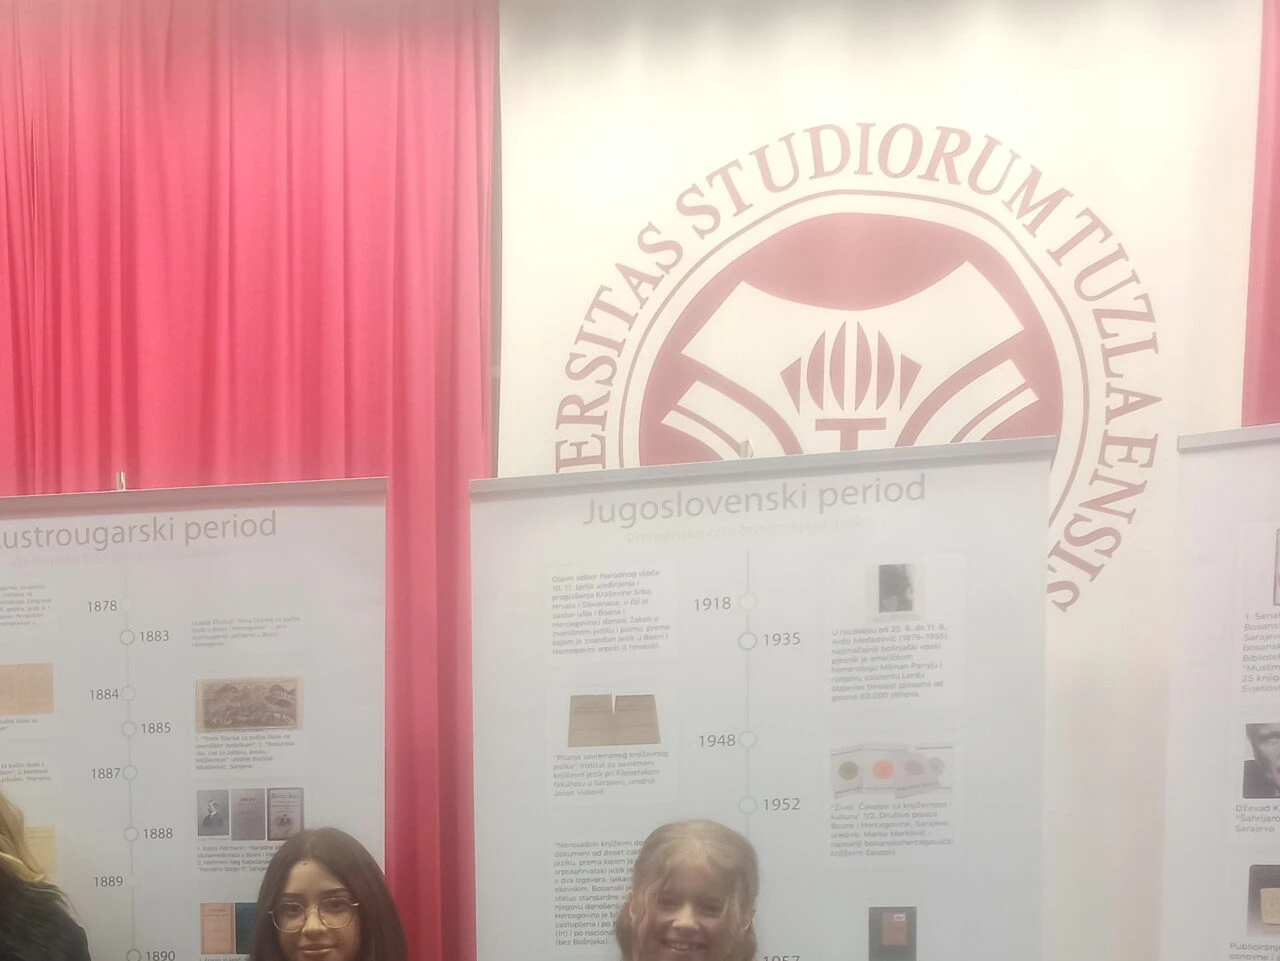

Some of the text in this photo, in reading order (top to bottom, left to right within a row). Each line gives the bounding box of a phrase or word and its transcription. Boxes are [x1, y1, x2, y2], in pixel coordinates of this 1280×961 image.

[554, 122, 1163, 613] ERSITAS STUDIORUM TUZLAENSIS
[583, 472, 926, 529] Jugoslovenski period
[185, 509, 277, 547] period
[87, 600, 118, 612] 1878
[694, 596, 732, 611] 1918
[139, 631, 170, 643] 1883
[763, 631, 801, 647] 1935
[1244, 633, 1280, 642] Sarajev
[89, 689, 120, 701] 1884
[141, 723, 171, 735] 1885
[698, 733, 736, 748] 1948
[91, 767, 121, 780] 1887
[763, 797, 800, 811] 1952
[143, 828, 174, 840] 1888
[94, 876, 124, 888] 1889
[1229, 942, 1280, 952] Publiciranj
[146, 951, 176, 961] 1890
